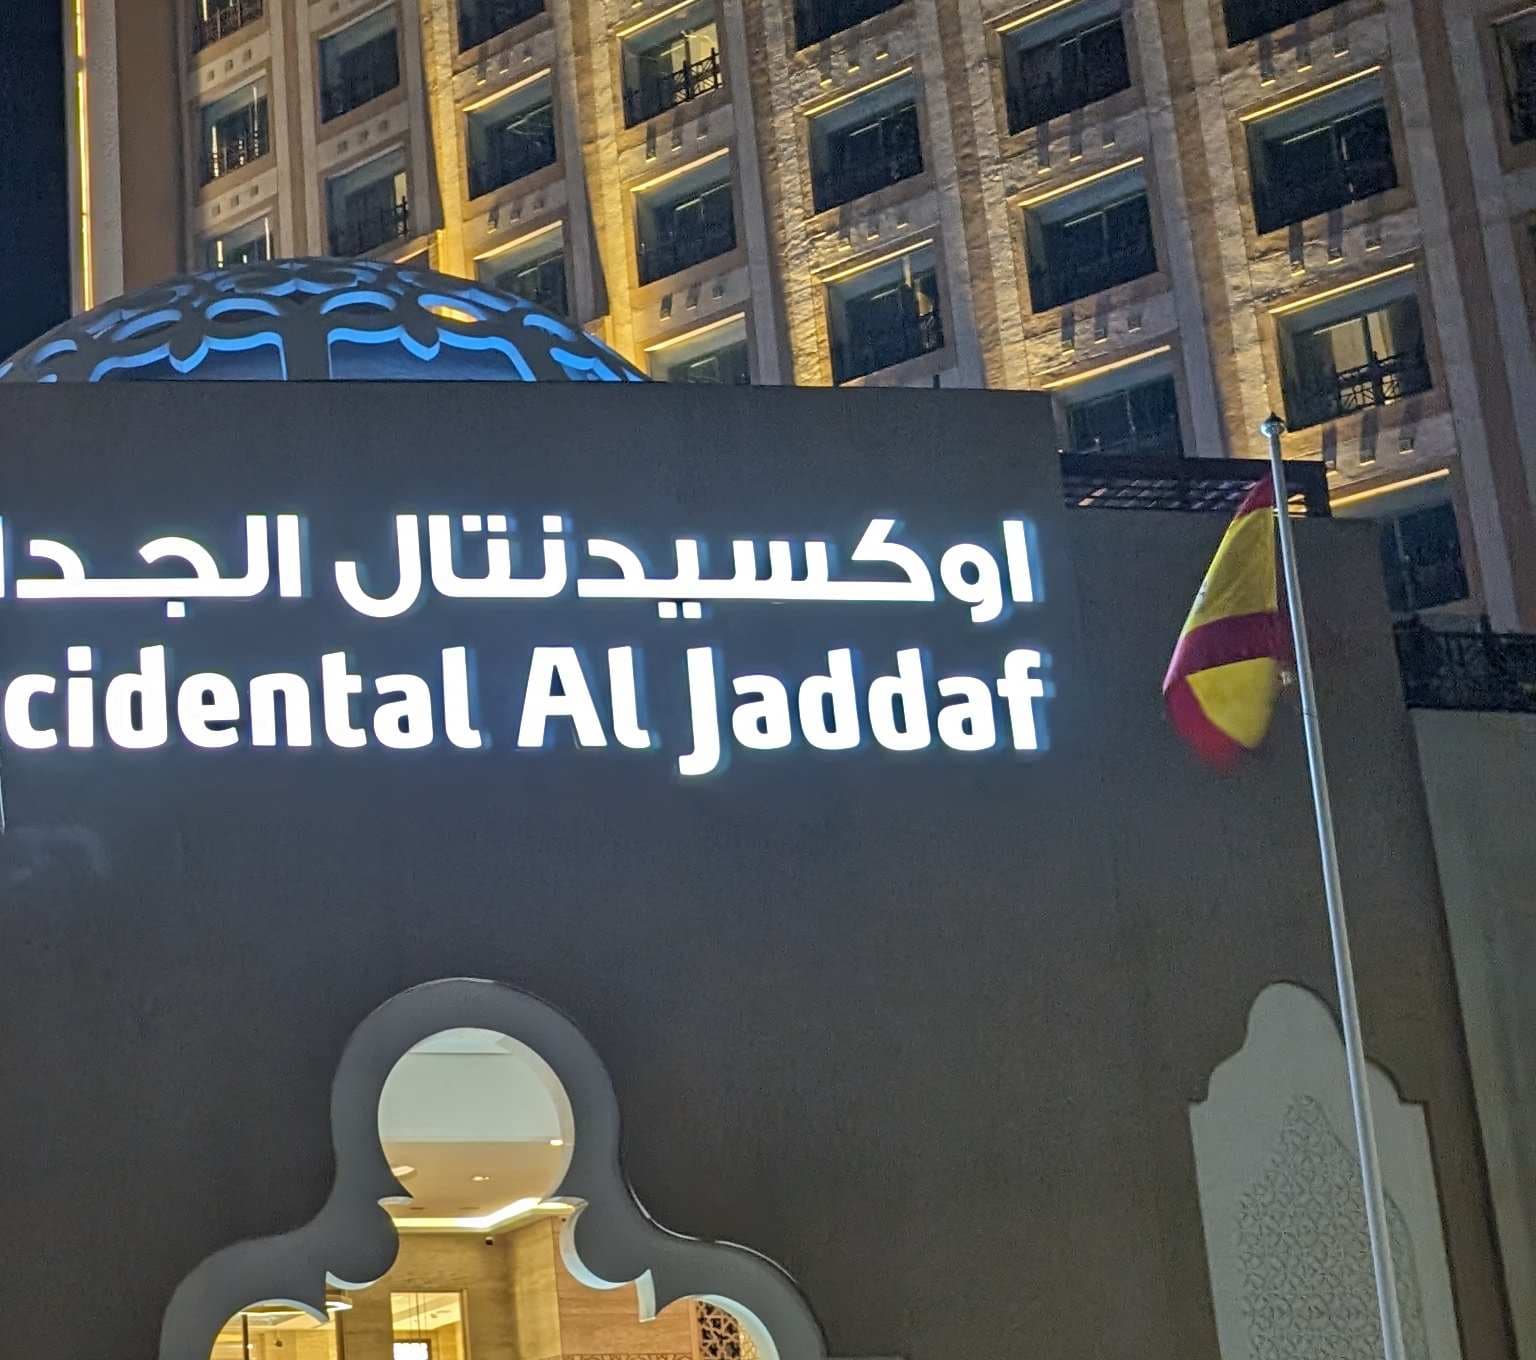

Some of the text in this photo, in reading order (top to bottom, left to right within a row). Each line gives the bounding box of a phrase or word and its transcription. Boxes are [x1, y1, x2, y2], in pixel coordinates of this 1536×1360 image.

[334, 514, 1035, 623] اوكسيدنتال
[516, 645, 652, 749] Al
[677, 646, 1045, 776] Jaddaf
